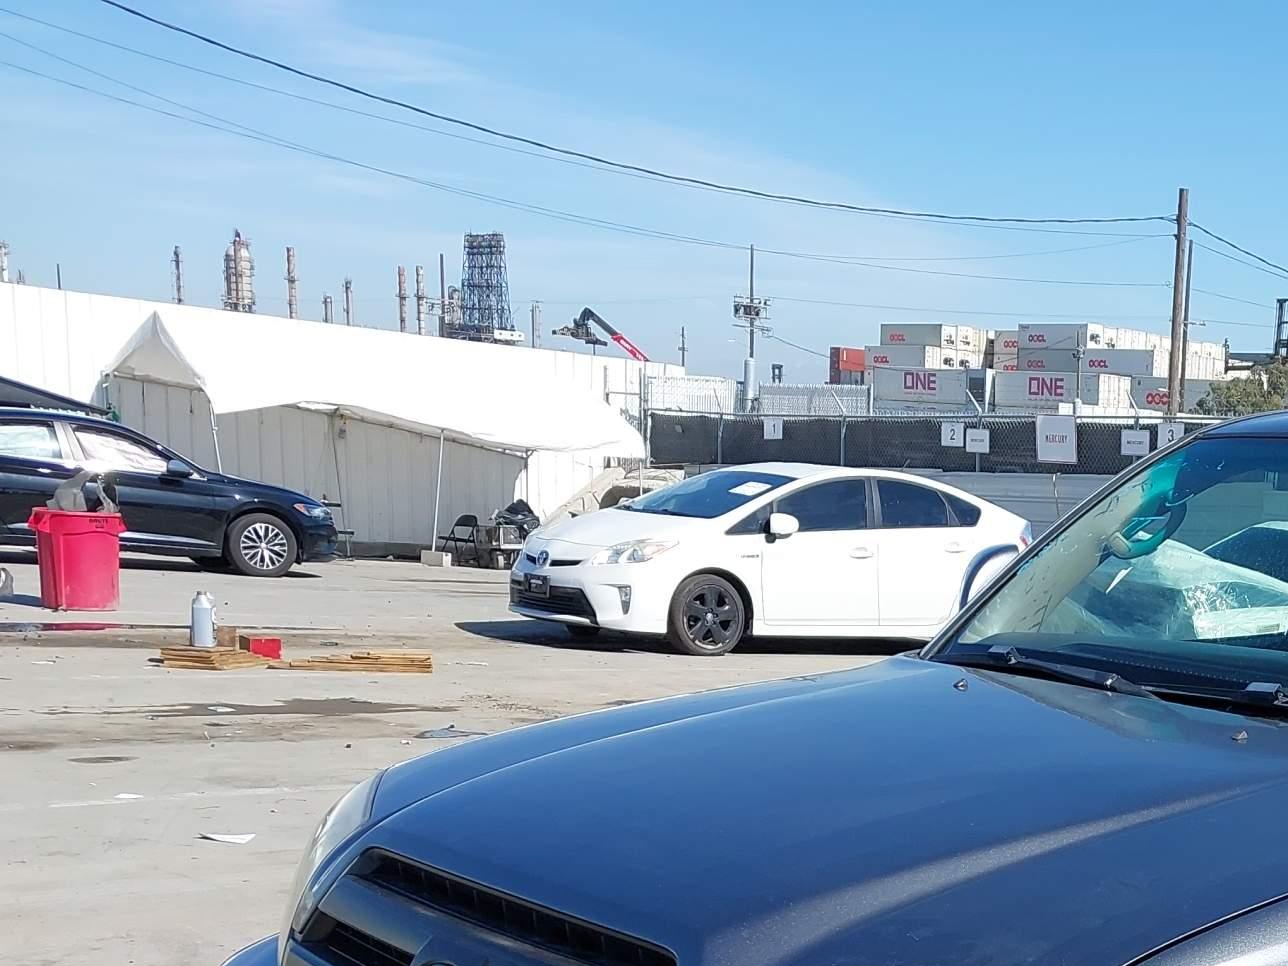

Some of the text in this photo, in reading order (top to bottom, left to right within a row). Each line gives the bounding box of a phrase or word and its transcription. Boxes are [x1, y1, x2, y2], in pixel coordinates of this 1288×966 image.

[1028, 333, 1047, 343] OOCL
[1003, 340, 1018, 349] OOC
[1088, 359, 1109, 369] OOCL
[903, 371, 937, 391] ONE
[1028, 376, 1065, 397] ONE
[949, 428, 956, 441] 2
[1045, 434, 1068, 444] MERCURY
[1167, 429, 1175, 442] 3
